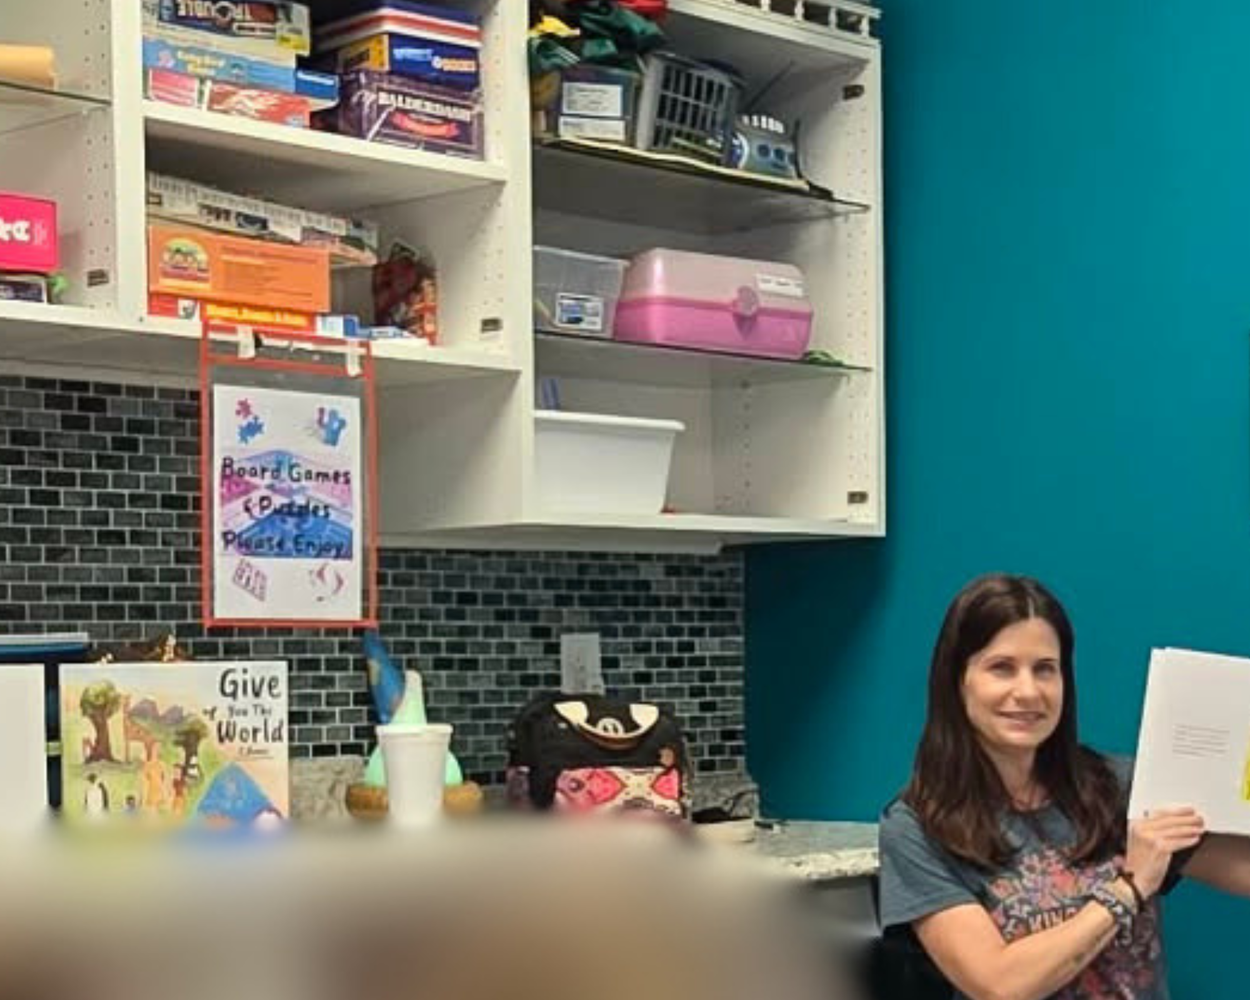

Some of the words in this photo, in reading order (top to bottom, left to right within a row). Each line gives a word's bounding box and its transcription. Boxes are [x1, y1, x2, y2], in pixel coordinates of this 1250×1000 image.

[222, 457, 281, 480] Board
[288, 464, 351, 485] Games
[293, 534, 344, 560] Enjoy
[220, 668, 281, 701] Give
[217, 719, 284, 744] World
